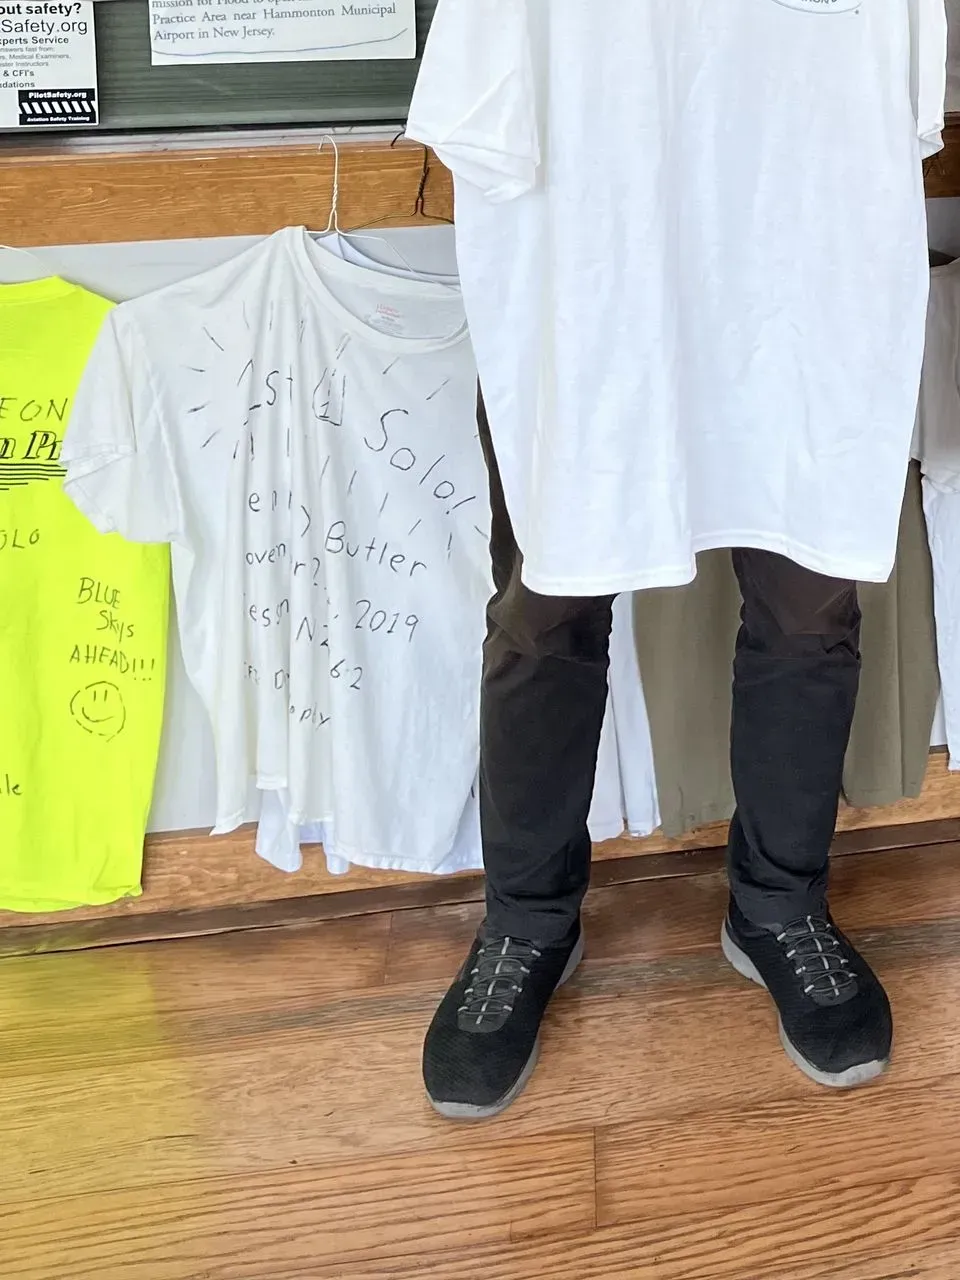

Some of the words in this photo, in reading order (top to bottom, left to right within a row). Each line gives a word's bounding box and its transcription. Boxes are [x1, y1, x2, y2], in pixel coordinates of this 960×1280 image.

[26, 3, 82, 17] safety?
[152, 12, 196, 25] Practice
[201, 11, 226, 23] Area
[233, 11, 257, 21] near
[263, 6, 335, 20] Hammonton
[341, 3, 396, 18] Municipal
[31, 36, 69, 45] Service
[154, 30, 194, 43] Airport
[198, 28, 209, 40] in
[213, 26, 239, 38] New
[242, 25, 275, 40] Jersey.
[28, 91, 87, 99] PilotSafety.org
[325, 520, 427, 577] Butler
[77, 576, 120, 610] BLUE
[355, 599, 419, 642] 2019
